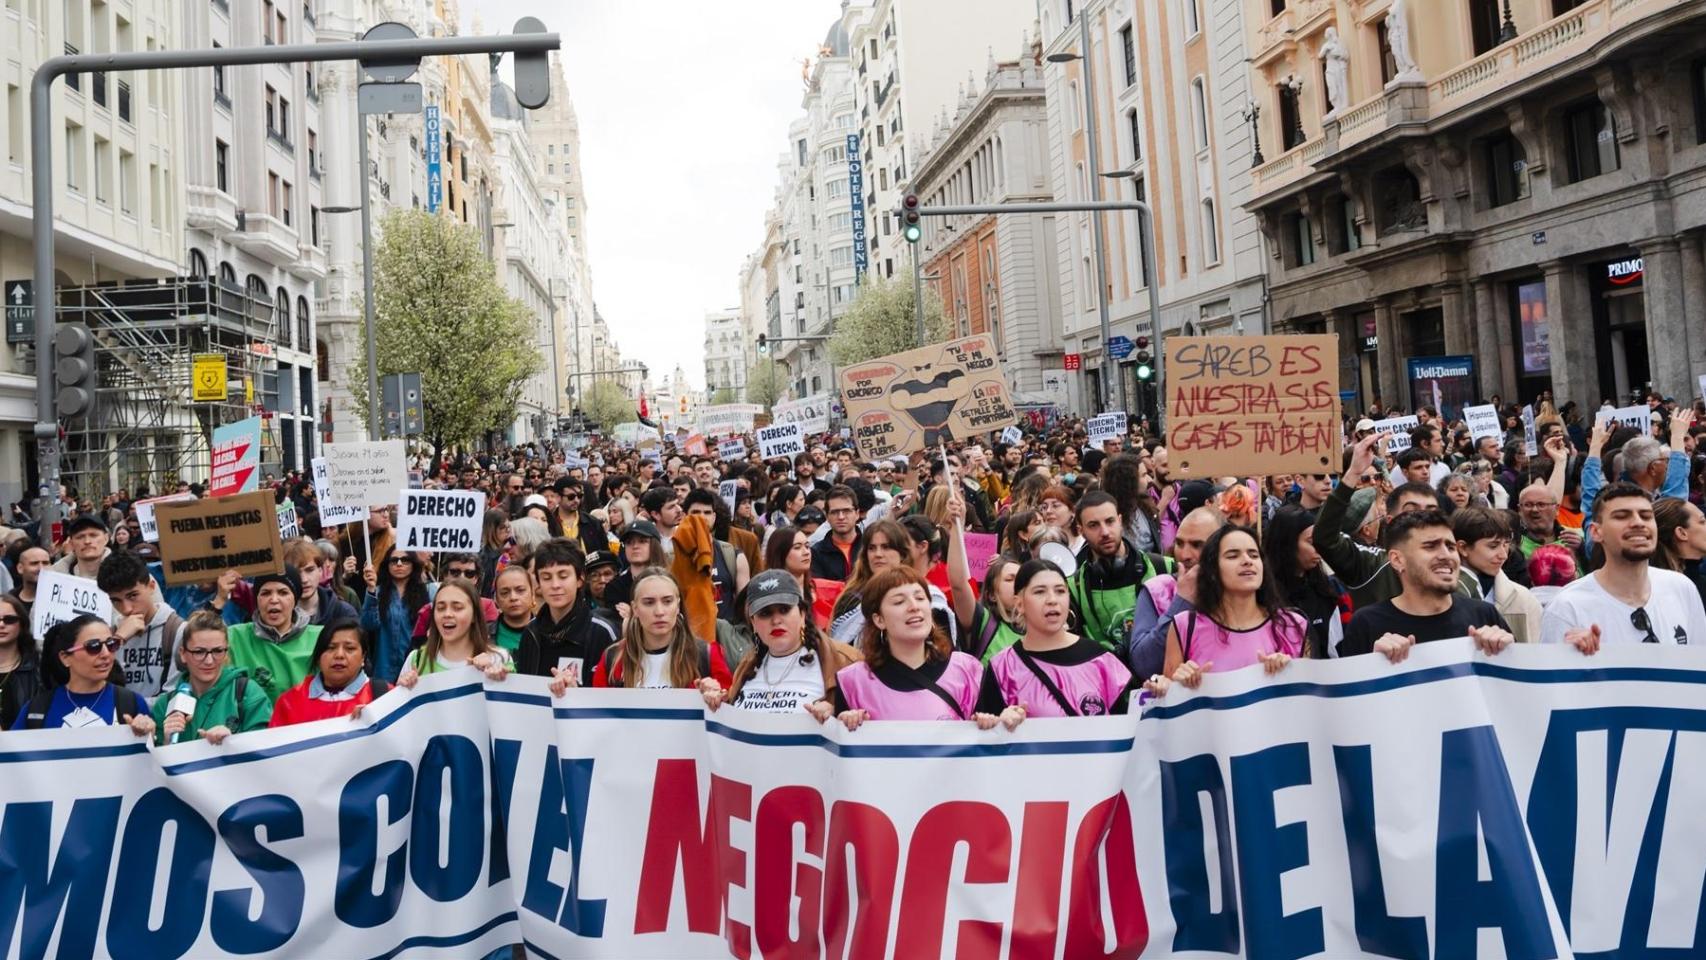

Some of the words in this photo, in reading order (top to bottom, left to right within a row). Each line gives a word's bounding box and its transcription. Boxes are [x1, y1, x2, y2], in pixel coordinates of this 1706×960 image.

[427, 109, 439, 164] HOTEL
[849, 153, 861, 205] HOTEL
[853, 210, 866, 276] REGENT
[1608, 258, 1643, 277] PRIMO
[946, 346, 961, 355] TU
[956, 353, 968, 362] ES
[971, 350, 983, 360] MI
[1175, 343, 1272, 380] SAREB
[1279, 345, 1322, 376] ES
[1415, 366, 1468, 379] Voll-Damm
[856, 379, 872, 387] POR
[973, 388, 985, 399] LA
[978, 398, 988, 407] ES
[990, 396, 1002, 405] UN
[1175, 382, 1286, 421] NUESTRA,
[1285, 381, 1334, 413] SUS
[960, 405, 991, 418] DETALLE
[760, 425, 797, 441] DERECHO
[857, 421, 895, 438] ABUELAS
[1171, 421, 1243, 450] CASAS
[766, 446, 773, 457] A
[773, 441, 802, 455] TECHO.
[861, 438, 873, 449] ES
[876, 435, 886, 446] MI
[323, 505, 349, 519] justos,
[407, 495, 476, 518] DERECHO
[170, 517, 205, 534] FUERA
[205, 509, 262, 530] RENTISTAS
[211, 535, 227, 549] DE
[407, 527, 418, 547] A
[422, 527, 473, 549] TECHO.
[171, 555, 227, 574] NUESTROS
[227, 548, 273, 568] BARRIOS
[72, 588, 100, 611] S.O.S.
[126, 671, 145, 684] 991
[744, 699, 797, 710] VIVIENDA
[0, 786, 304, 960] MOS
[521, 745, 607, 938] EL
[634, 758, 1149, 960] NEGOCIO
[1159, 741, 1331, 960] DE
[1333, 724, 1560, 960] LA
